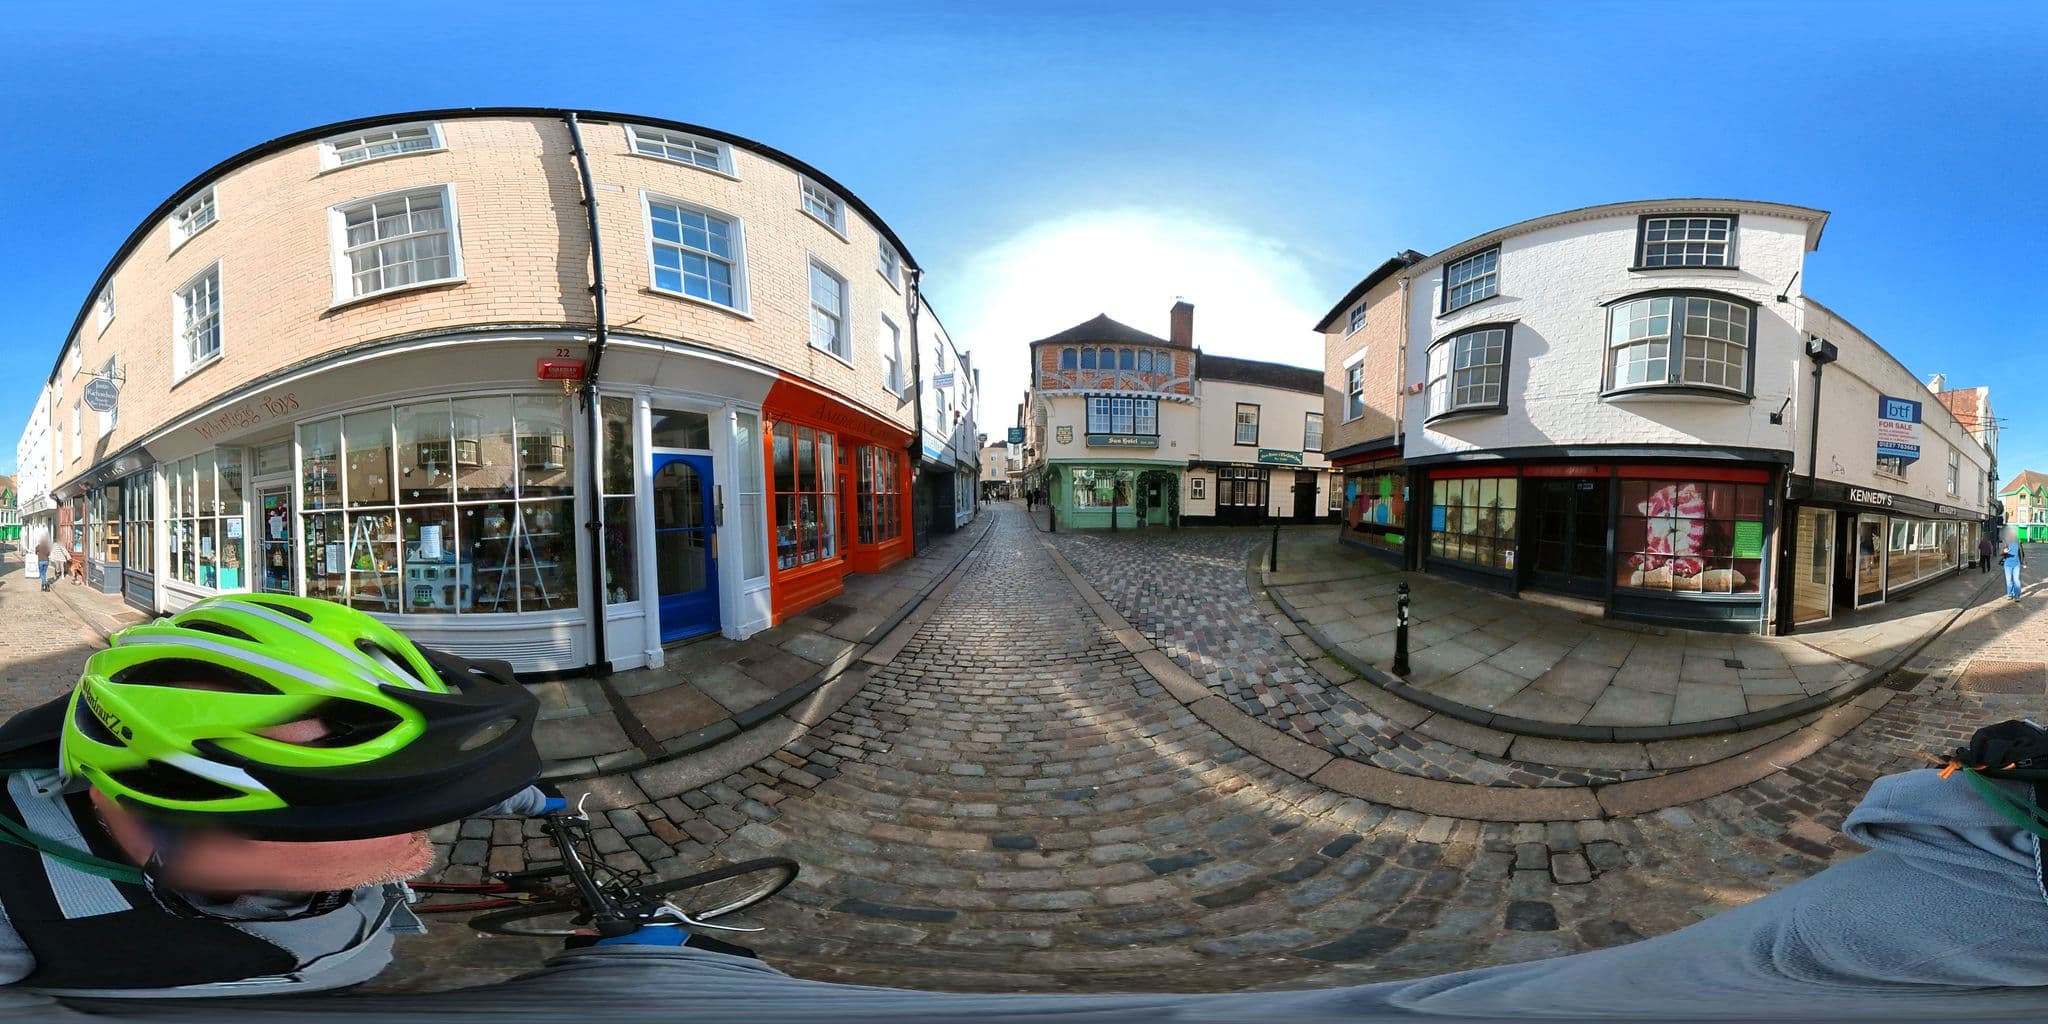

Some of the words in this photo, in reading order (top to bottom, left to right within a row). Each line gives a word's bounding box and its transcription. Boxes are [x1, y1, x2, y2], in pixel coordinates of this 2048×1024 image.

[556, 348, 570, 358] 22
[1889, 402, 1912, 419] btf
[194, 403, 262, 441] Whirligig
[261, 392, 300, 418] Toys
[1879, 421, 1894, 429] FOR
[1895, 422, 1913, 431] SALE
[1122, 437, 1138, 445] Hotel
